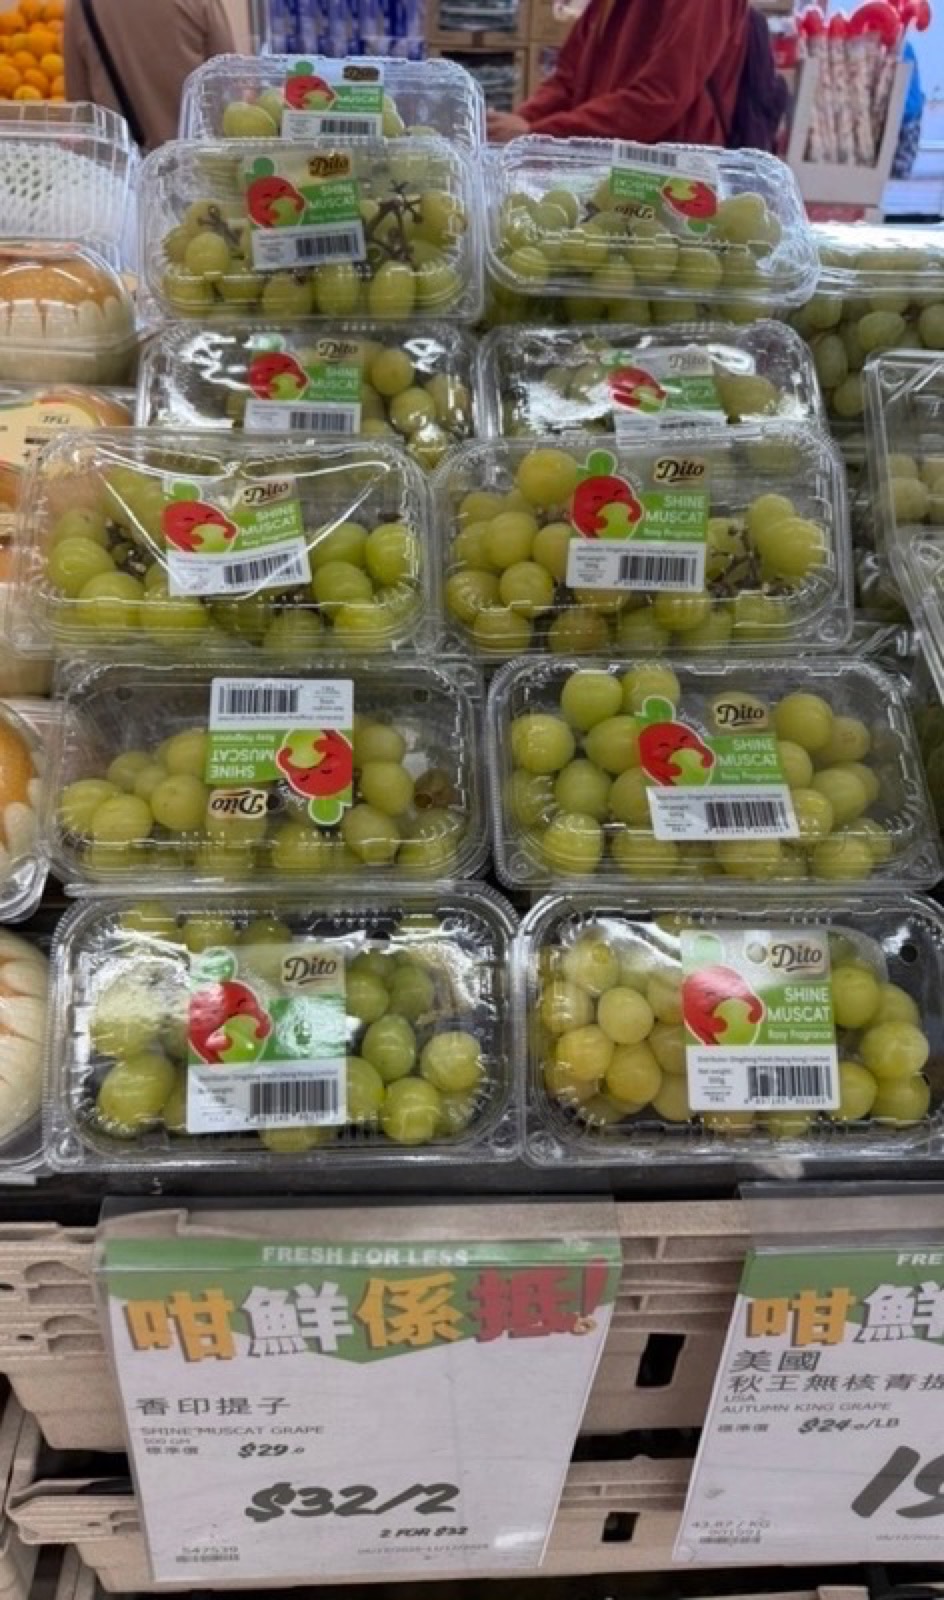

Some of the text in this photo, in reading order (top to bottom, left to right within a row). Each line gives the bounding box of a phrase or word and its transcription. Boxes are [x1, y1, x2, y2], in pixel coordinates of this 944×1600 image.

[655, 458, 705, 482] Dito
[243, 482, 289, 505] Dito
[663, 495, 705, 509] SHINE
[645, 510, 704, 524] MUSCAT
[717, 703, 765, 727] Dito
[733, 738, 776, 751] SHINE
[211, 749, 275, 763] MUSCAT
[718, 753, 778, 767] MUSCAT
[211, 765, 256, 779] SHINE
[211, 790, 264, 815] Dito
[772, 943, 823, 972] Dito
[284, 955, 337, 985] Dito
[784, 987, 829, 1003] SHINE
[767, 1007, 831, 1022] MUSCAT
[262, 1246, 469, 1267] FRESH FOR LESS
[729, 1350, 822, 1372] 美國
[135, 1396, 291, 1416] 香印提子
[720, 1401, 892, 1413] AUTUMN KING GRAPE
[269, 1425, 325, 1435] GRAPE
[245, 1482, 460, 1523] $32/2
[379, 1528, 392, 1539] 2
[395, 1526, 432, 1538] FOR
